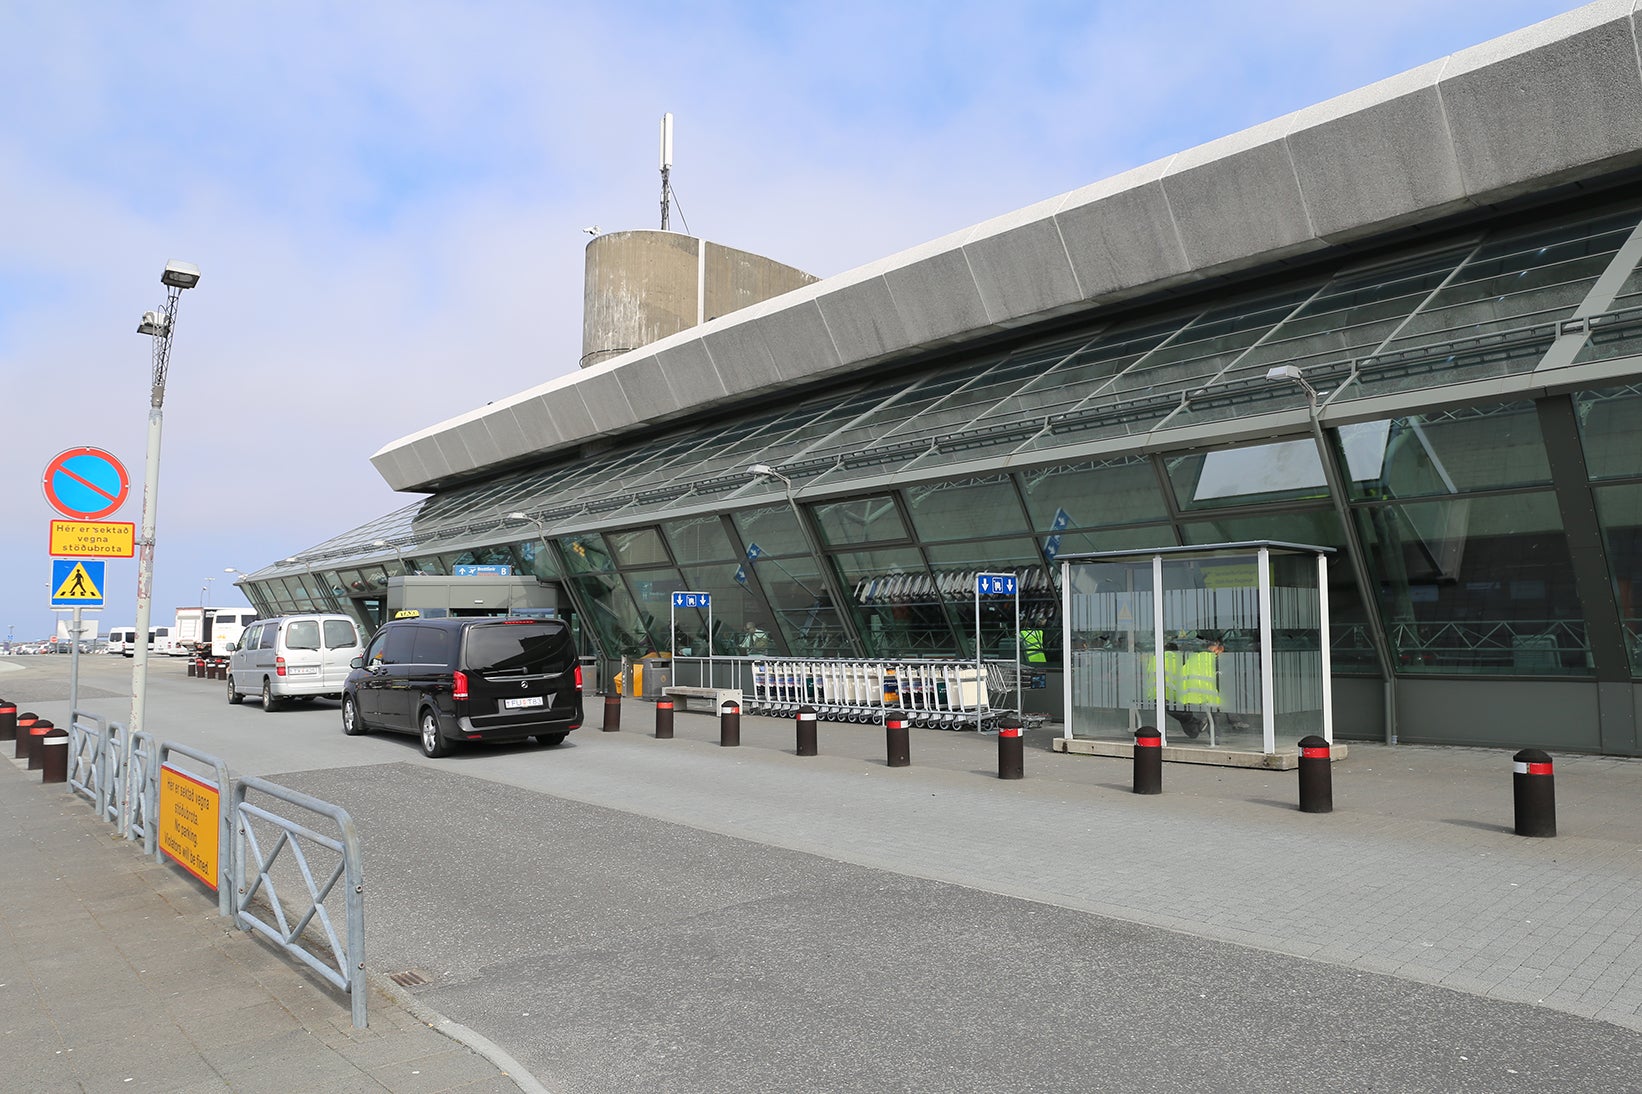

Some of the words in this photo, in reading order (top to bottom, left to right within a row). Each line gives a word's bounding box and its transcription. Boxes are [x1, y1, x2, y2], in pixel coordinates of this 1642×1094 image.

[62, 544, 122, 552] stöðubrota
[195, 794, 210, 811] vegna
[174, 818, 181, 833] No
[190, 850, 196, 866] be
